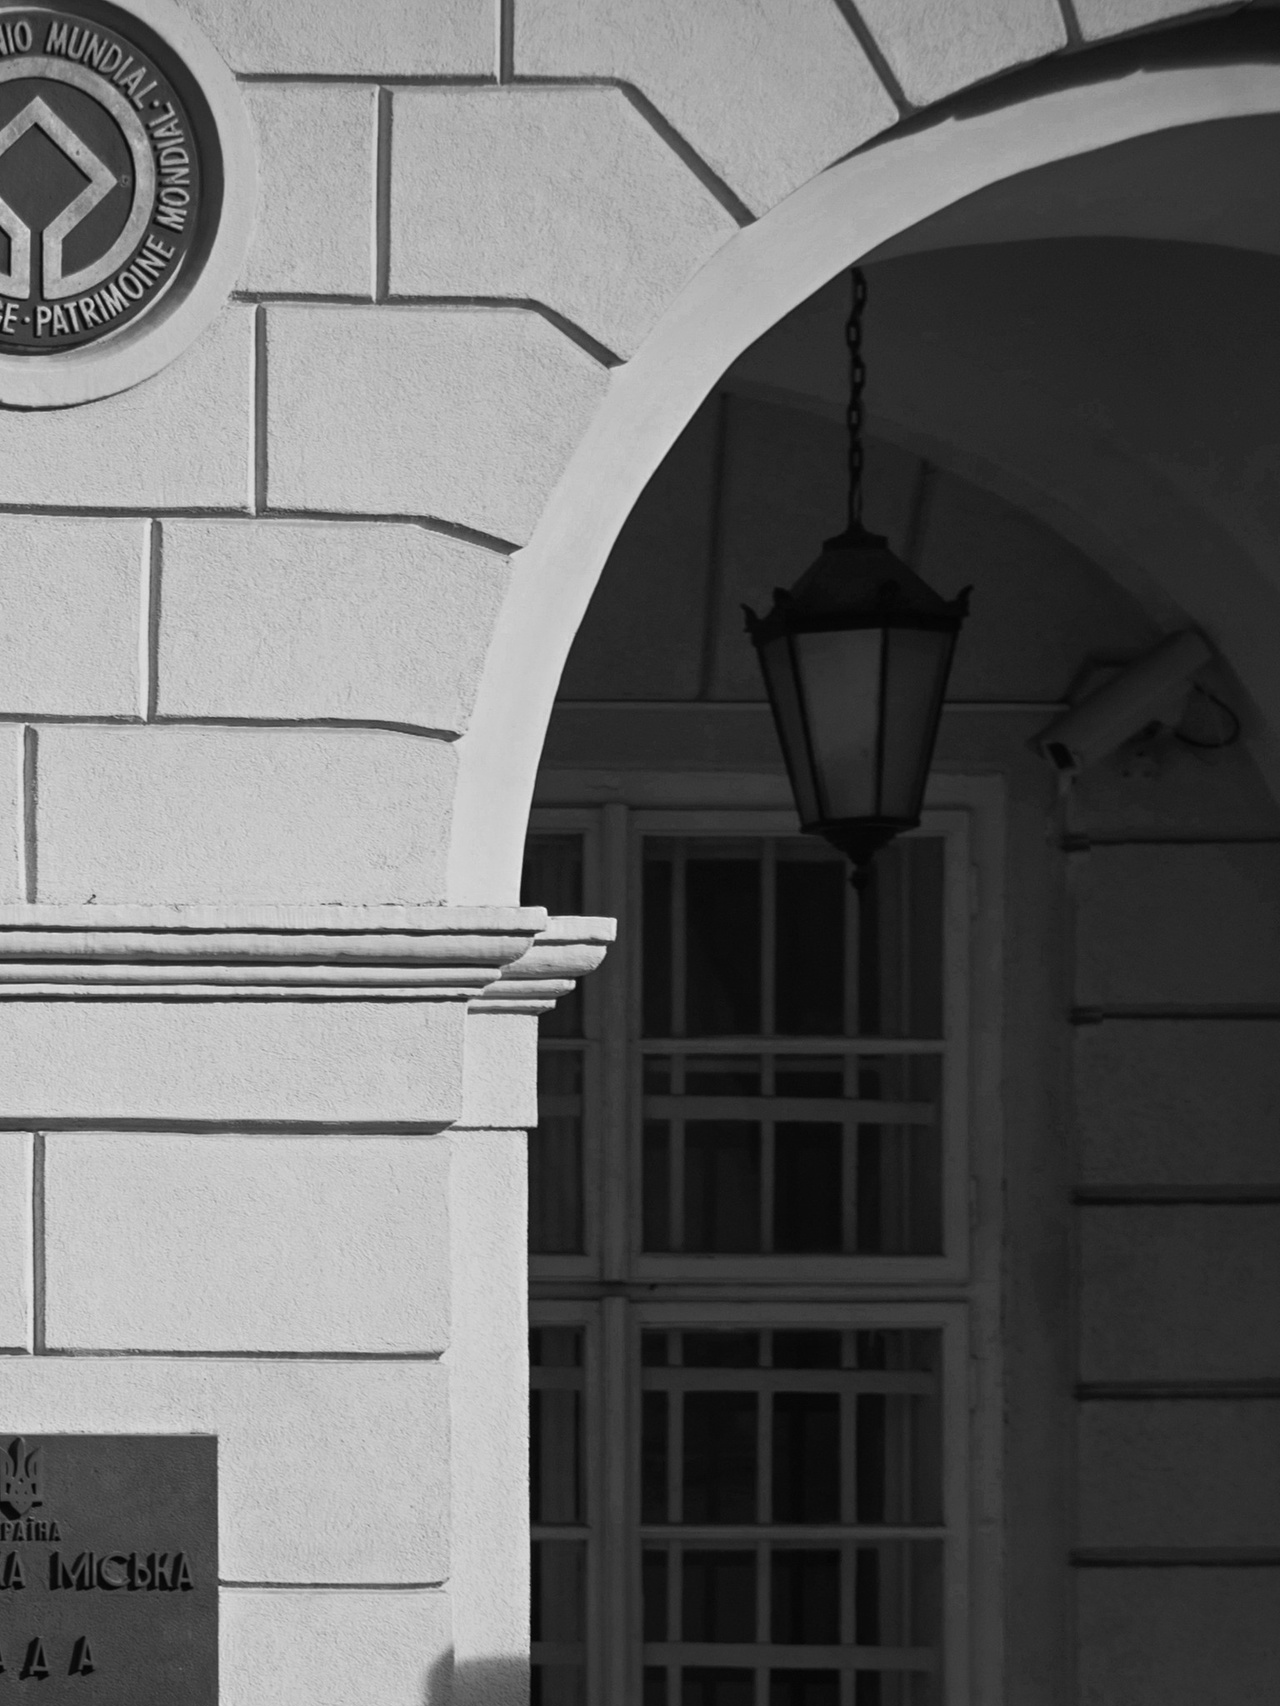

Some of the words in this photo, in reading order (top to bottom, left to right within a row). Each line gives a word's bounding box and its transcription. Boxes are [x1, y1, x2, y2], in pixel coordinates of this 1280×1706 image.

[45, 20, 159, 110] MUNDIAL
[34, 234, 175, 337] PATRIMOINE
[147, 101, 190, 232] MONDIAL
[49, 1550, 194, 1591] МІСЬКА
